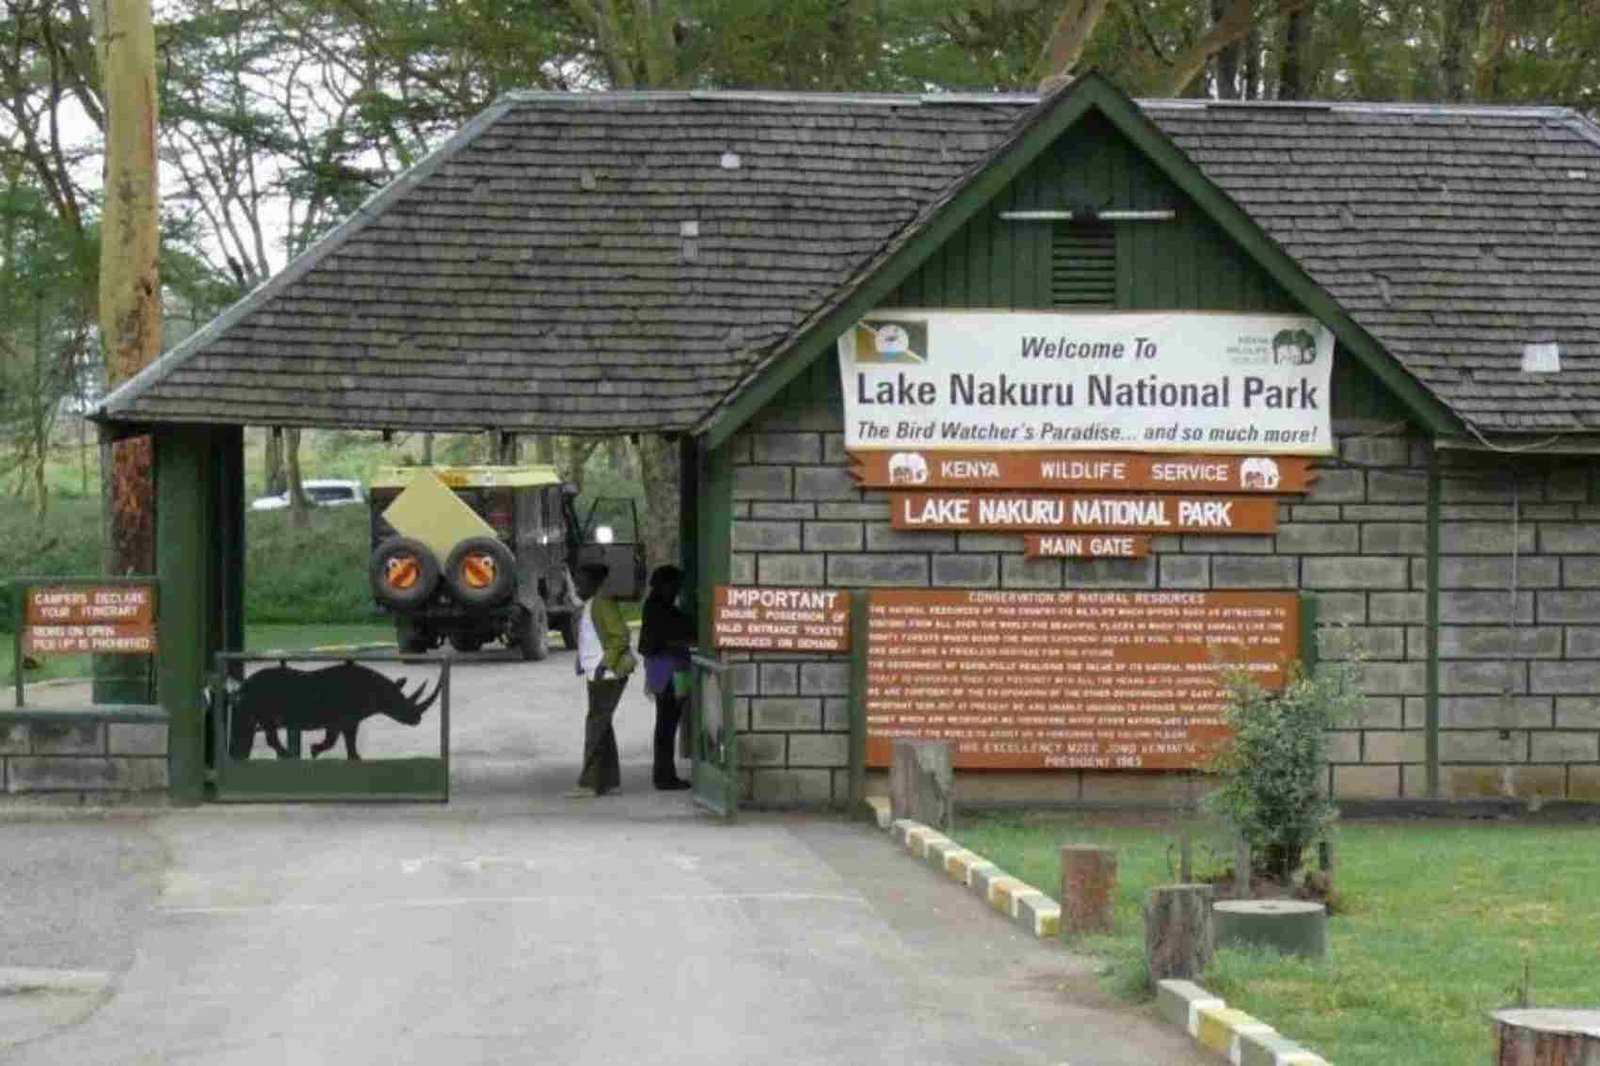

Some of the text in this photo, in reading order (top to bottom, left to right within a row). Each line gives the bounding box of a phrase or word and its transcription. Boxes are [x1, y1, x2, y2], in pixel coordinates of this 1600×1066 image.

[1021, 336, 1157, 358] Welcome To
[858, 372, 1318, 409] Lake Nakuru National Park
[858, 421, 1318, 443] The Bird Watcher's Paradise... and so much more!
[942, 460, 1229, 482] KENYA WILDLIFE SERVICE
[904, 498, 1233, 527] LAKE NAKURU NATIONAL PARK
[1040, 537, 1135, 556] MAIN GATE
[95, 592, 145, 604] DECLARE
[727, 588, 837, 609] IMPORTANT
[967, 591, 1205, 604] CONSERVATION OF NATURAL RESOURCES
[40, 606, 71, 618] YOUR
[748, 624, 799, 635] ENTRANCE
[797, 638, 839, 649] DEMAND
[1044, 756, 1111, 769] PRESIDENT
